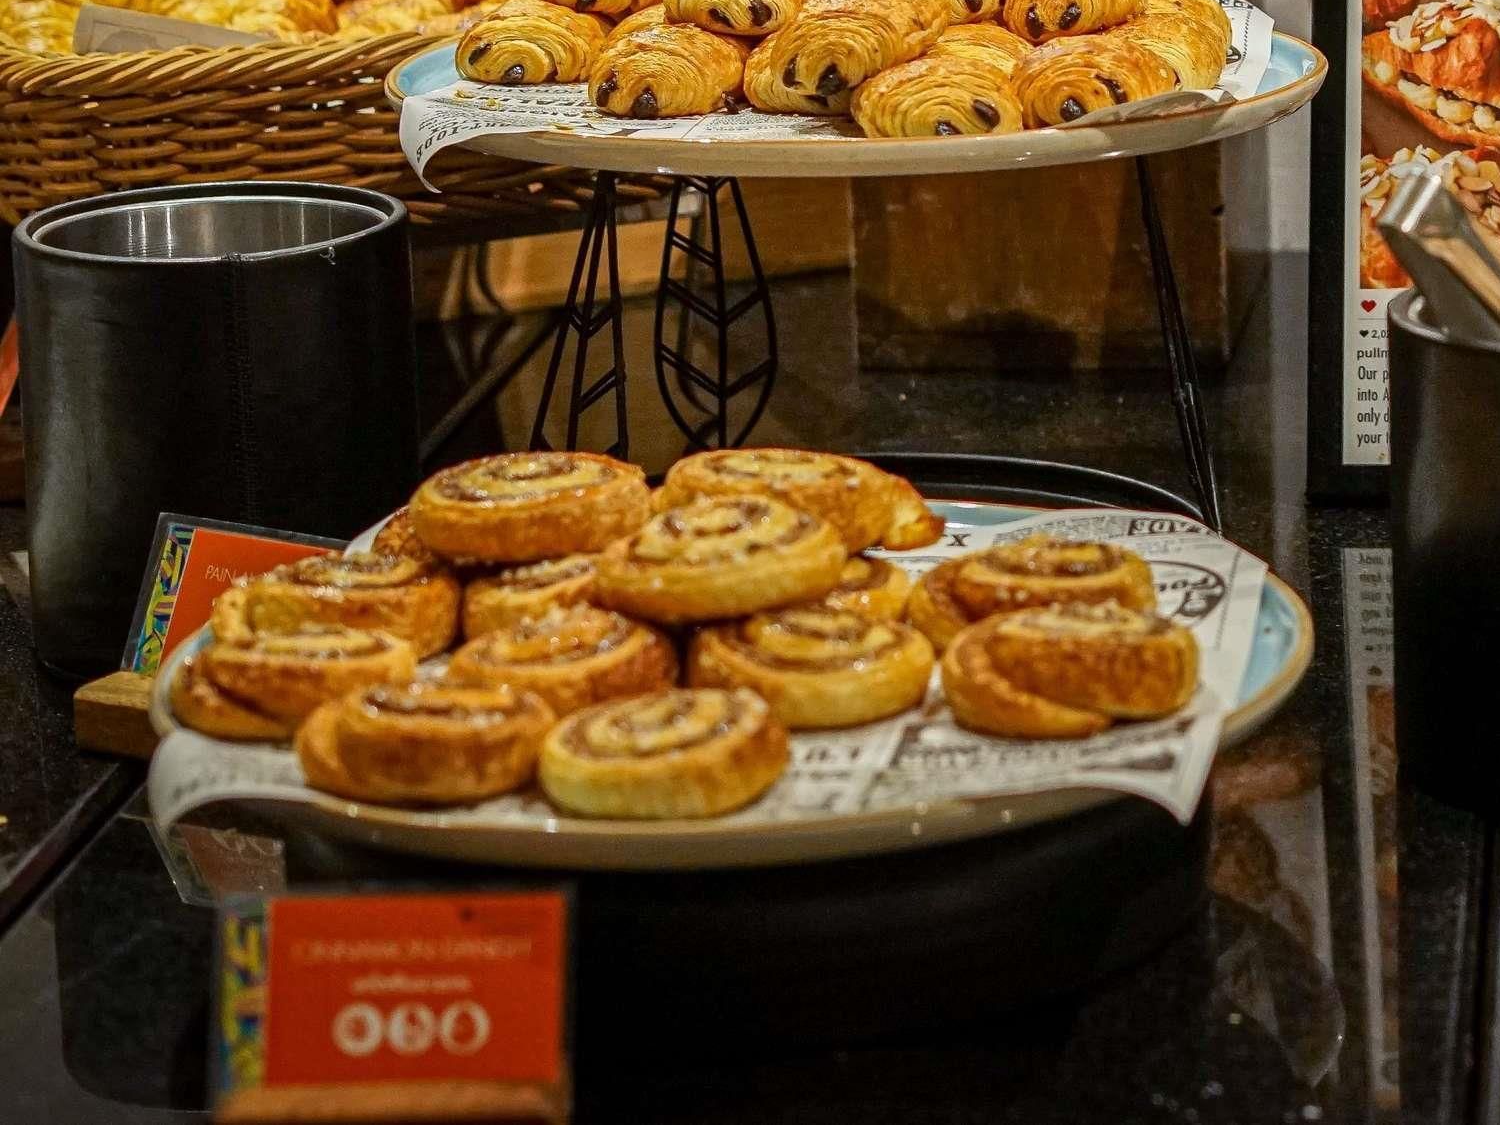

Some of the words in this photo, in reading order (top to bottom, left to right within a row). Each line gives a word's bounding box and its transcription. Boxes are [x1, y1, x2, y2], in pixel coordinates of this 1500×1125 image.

[1357, 365, 1378, 380] Our
[1357, 387, 1378, 402] into
[1357, 406, 1381, 426] only
[1356, 432, 1382, 448] your
